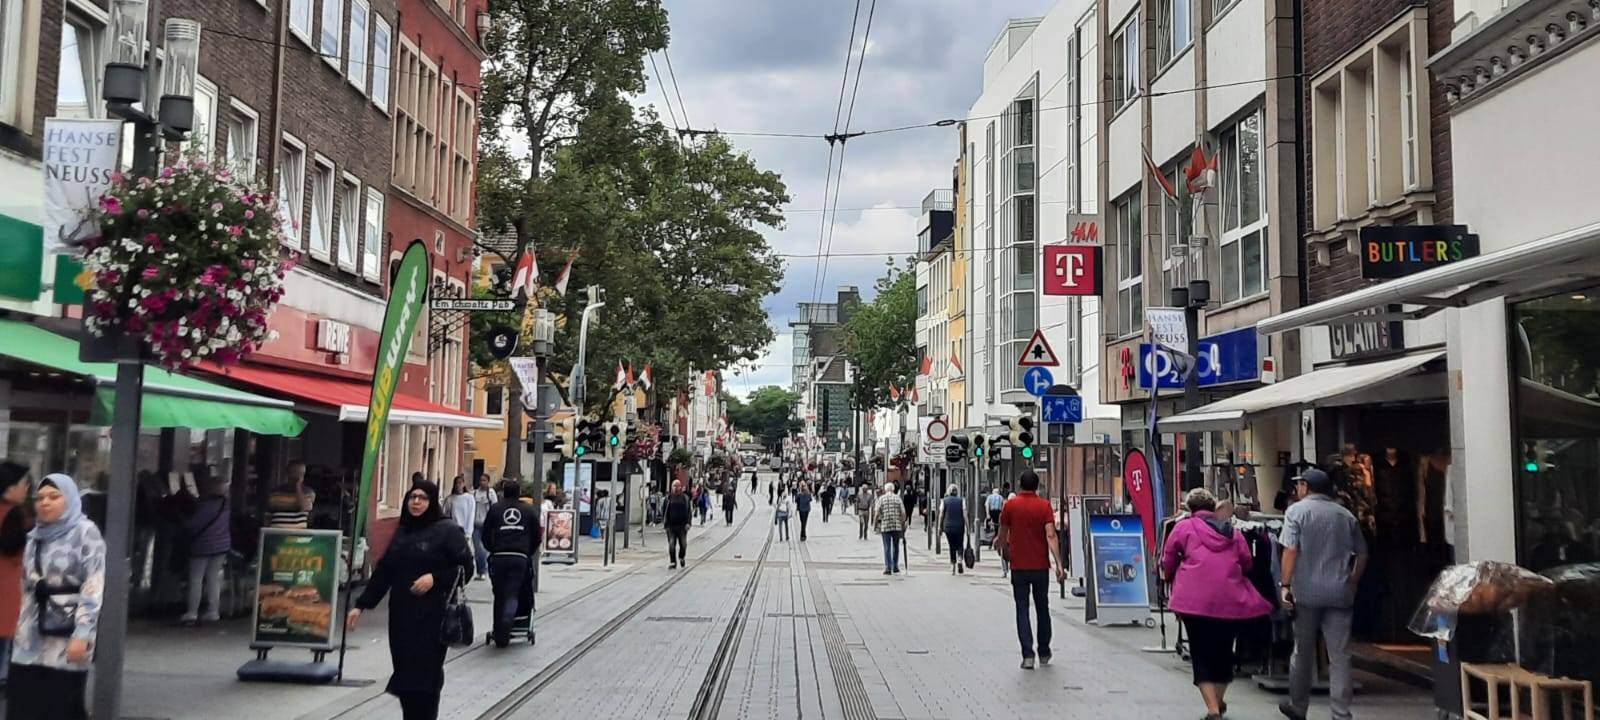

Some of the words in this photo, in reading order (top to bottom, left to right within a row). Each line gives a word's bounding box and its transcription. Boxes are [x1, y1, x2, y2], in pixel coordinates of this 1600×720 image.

[48, 127, 116, 146] HANSE
[46, 145, 96, 164] FEST
[46, 163, 112, 185] NEUSS
[1367, 240, 1462, 263] BUTLERS
[1055, 253, 1083, 287] T
[326, 321, 351, 353] REWE
[369, 265, 418, 450] SUBWAY
